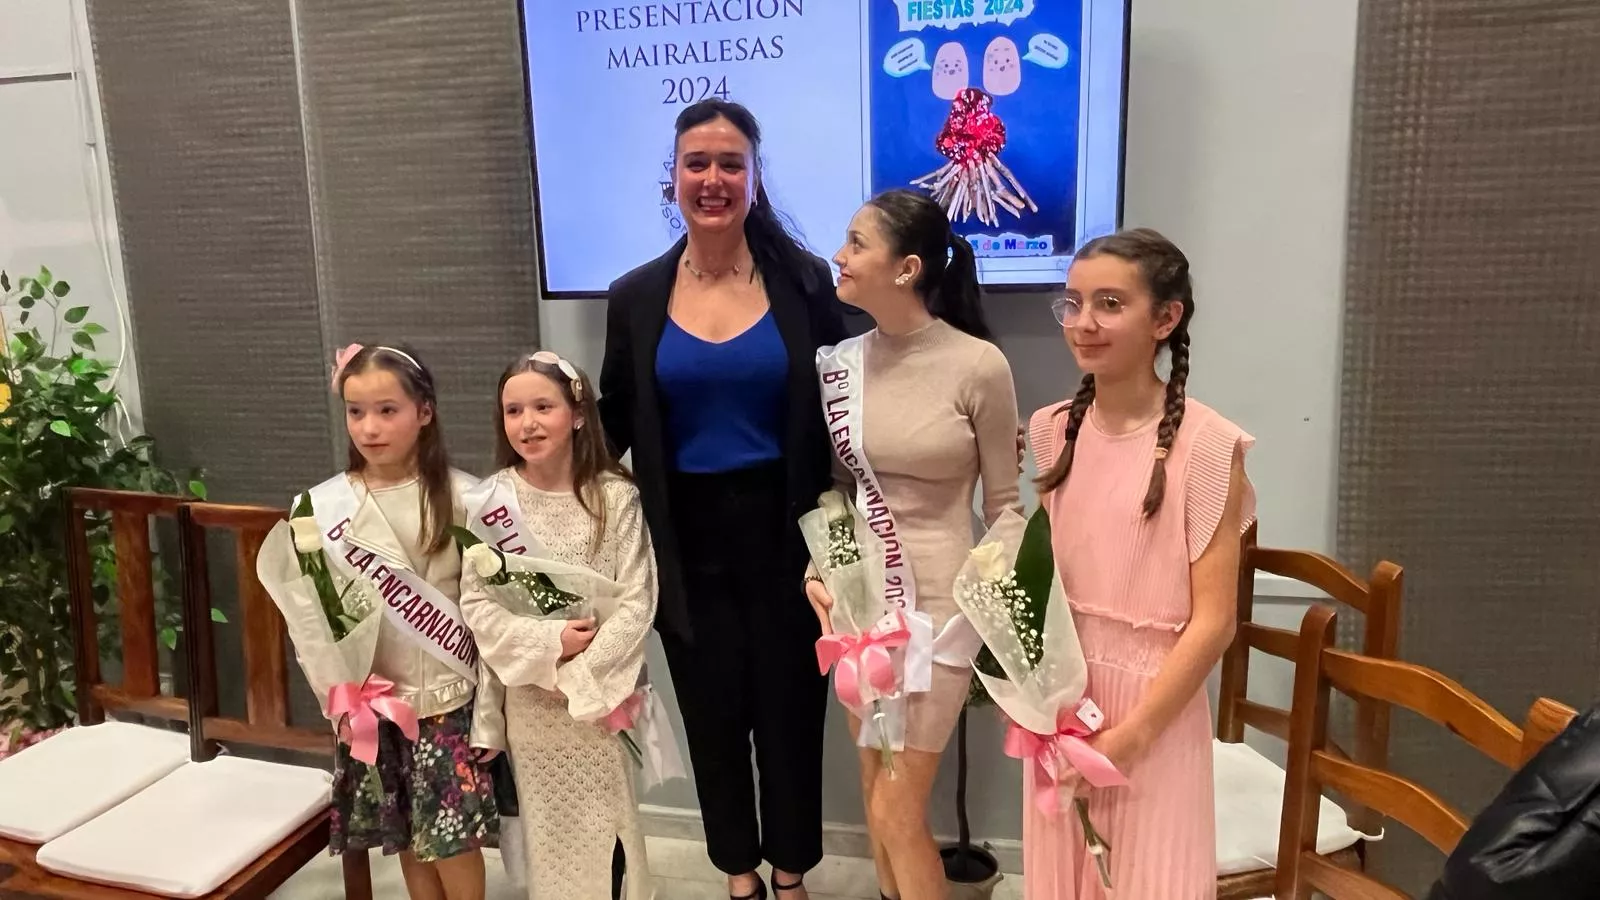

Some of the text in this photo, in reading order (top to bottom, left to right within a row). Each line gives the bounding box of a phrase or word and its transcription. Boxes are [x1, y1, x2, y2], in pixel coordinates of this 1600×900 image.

[907, 0, 1024, 21] FIESTAS 2024
[607, 35, 784, 69] MAIRALESAS
[662, 75, 730, 104] 2024
[1004, 238, 1047, 250] Marzo
[826, 395, 849, 426] LA
[345, 546, 376, 574] LA
